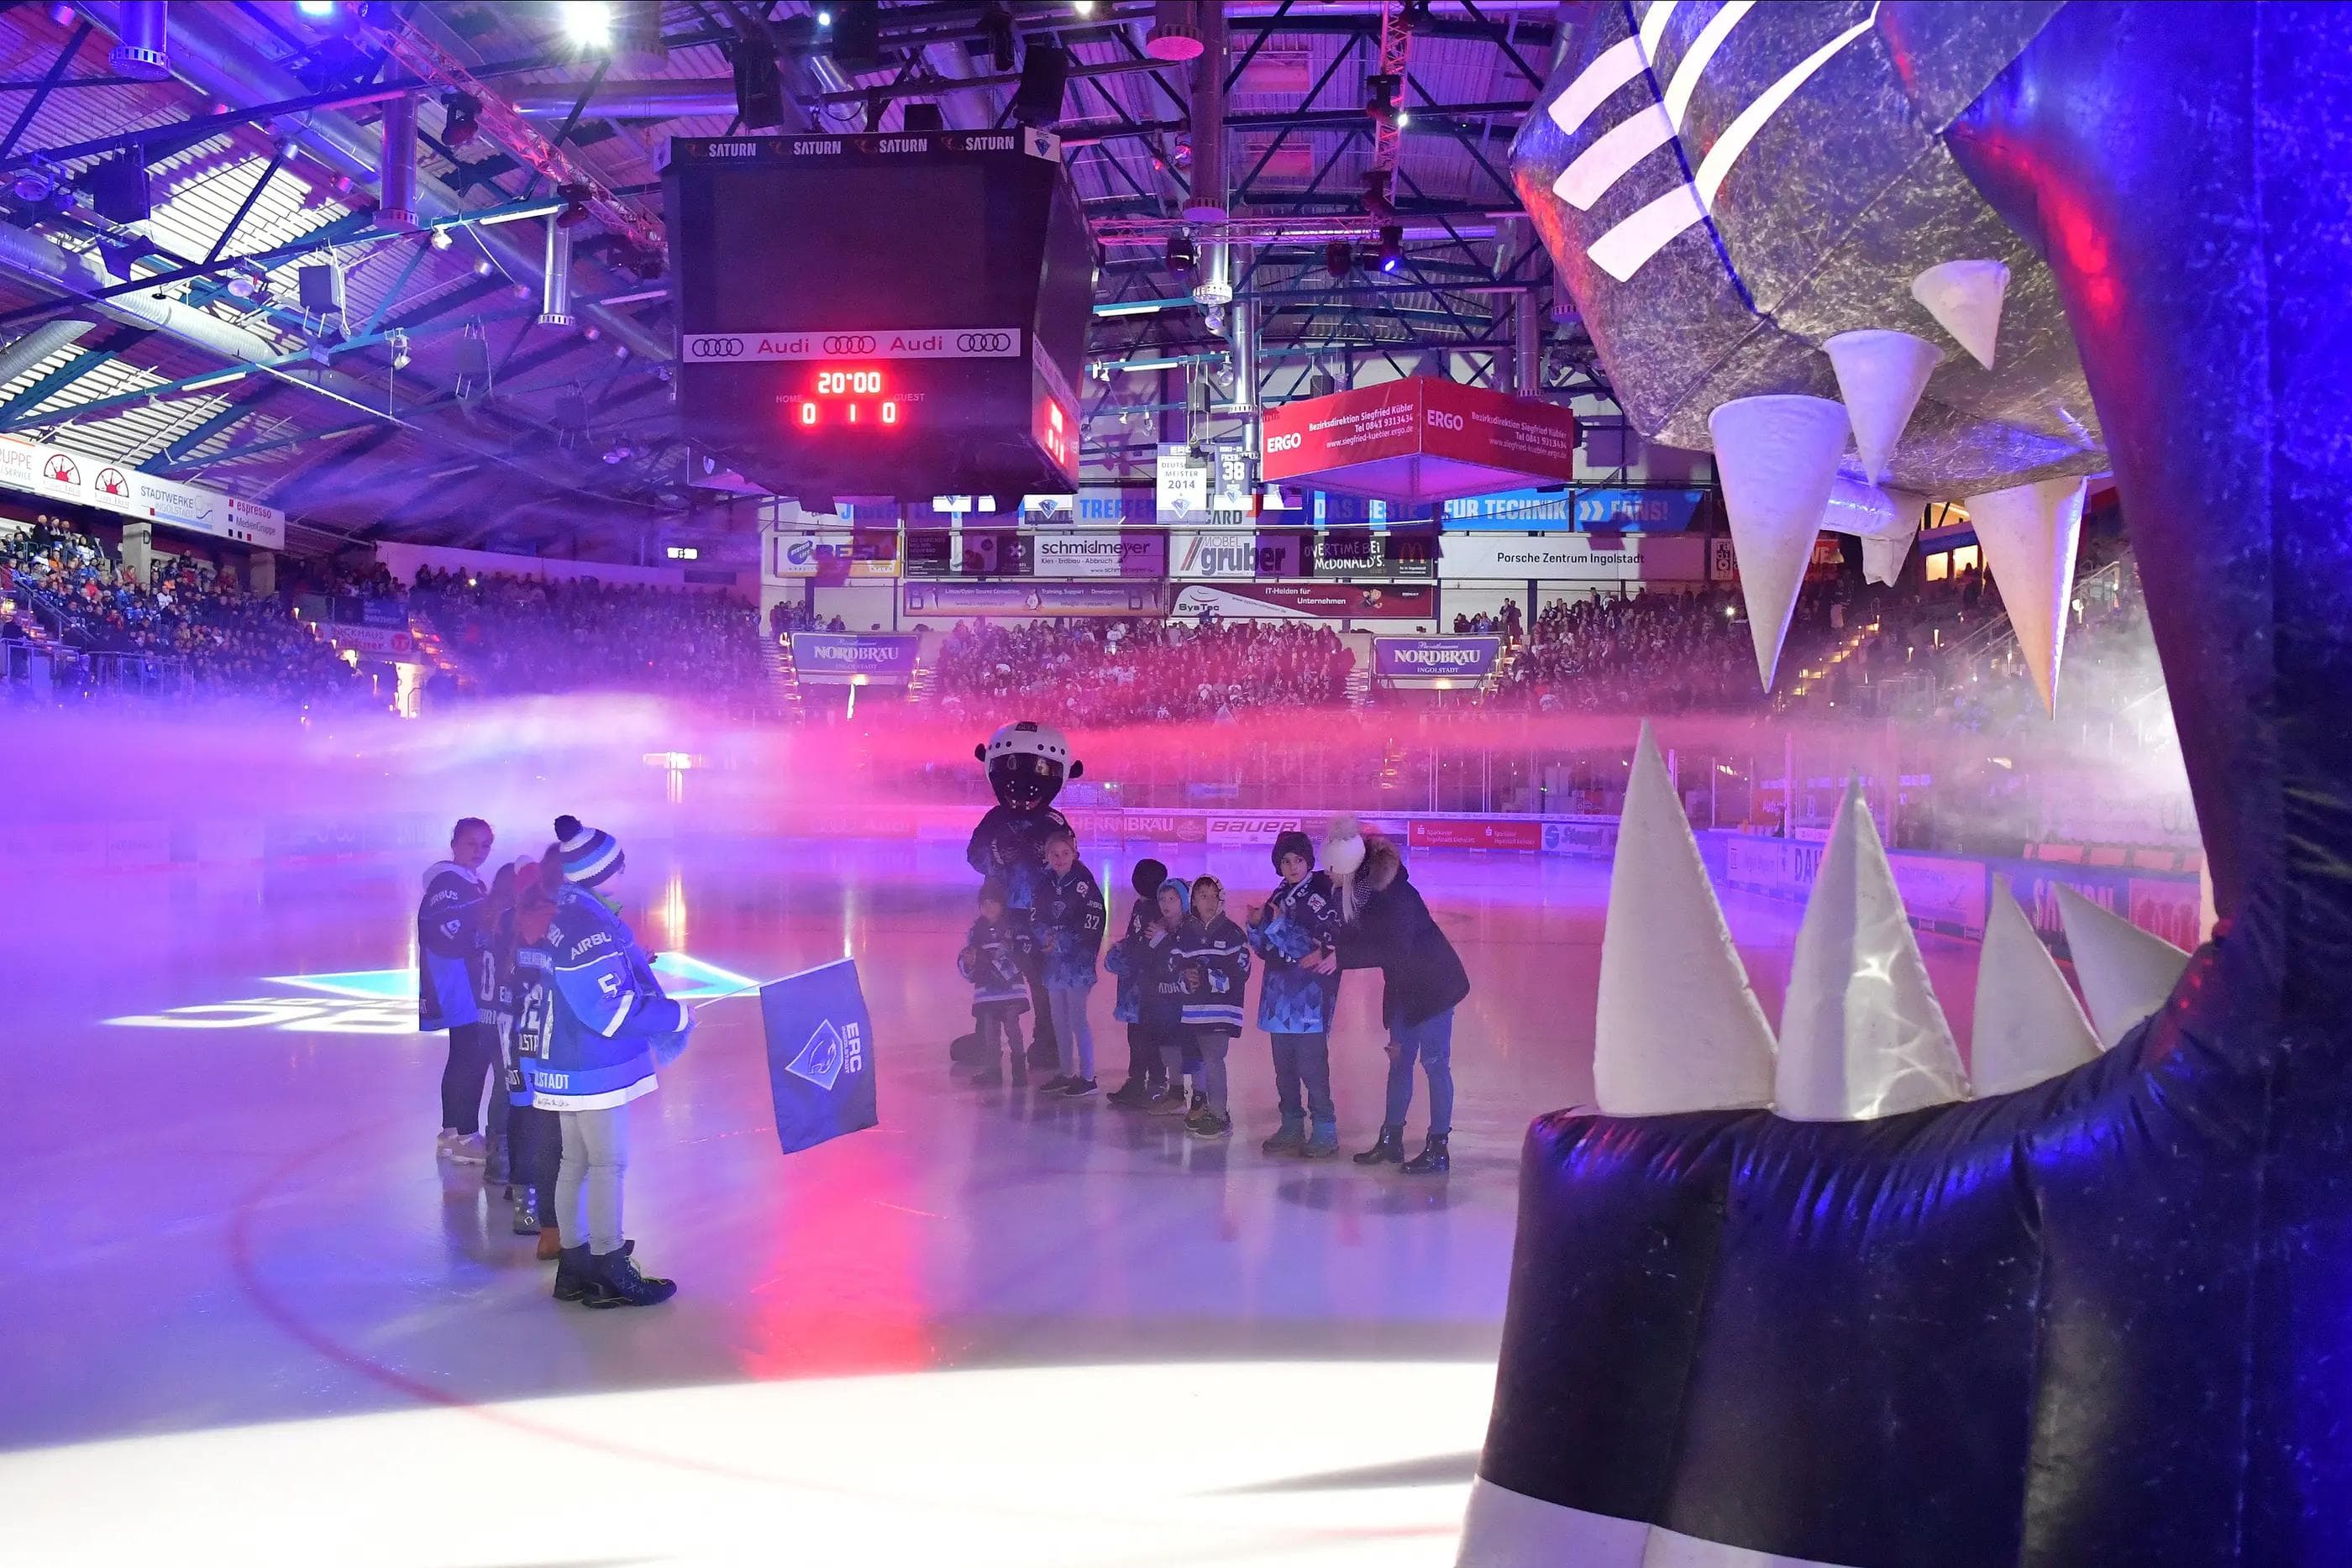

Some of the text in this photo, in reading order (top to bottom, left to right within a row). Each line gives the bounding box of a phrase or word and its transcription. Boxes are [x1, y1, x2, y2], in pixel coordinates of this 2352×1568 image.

[708, 143, 756, 157] SATURN
[793, 140, 841, 155] SATURN
[879, 139, 927, 153] SATURN
[965, 136, 1014, 151] SATURN
[758, 338, 809, 354] Audi
[890, 336, 942, 351] Audi
[775, 395, 803, 403] HOME
[894, 393, 925, 401] GUEST
[802, 403, 816, 424] 0
[850, 404, 856, 422] 1
[882, 402, 895, 423] 0
[1309, 403, 1414, 432] Bezirksdirektion Siegfried Kübler
[1427, 409, 1464, 432] ERGO
[1355, 424, 1365, 433] Tel
[1366, 421, 1383, 431] 0841
[1472, 411, 1520, 429] Bezirksdirektion
[1521, 422, 1548, 435] Siegfried
[1267, 433, 1302, 454] ERGO
[1515, 432, 1525, 441] Tel
[1222, 461, 1245, 480] 38
[1168, 480, 1195, 489] 2014
[140, 485, 194, 509] STADTWERKE
[236, 501, 272, 519] espresso
[1484, 499, 1567, 520] TECHNIK
[143, 530, 151, 544] D
[1042, 540, 1151, 559] schmidmeyer
[1200, 543, 1286, 576] gruber
[1497, 553, 1645, 566] Porsche Zentrum Ingolstadt
[1179, 603, 1220, 611] SysTec
[813, 646, 900, 663] NORDBRÄU
[570, 931, 612, 961] AIRBU
[846, 1021, 862, 1073] ERC
